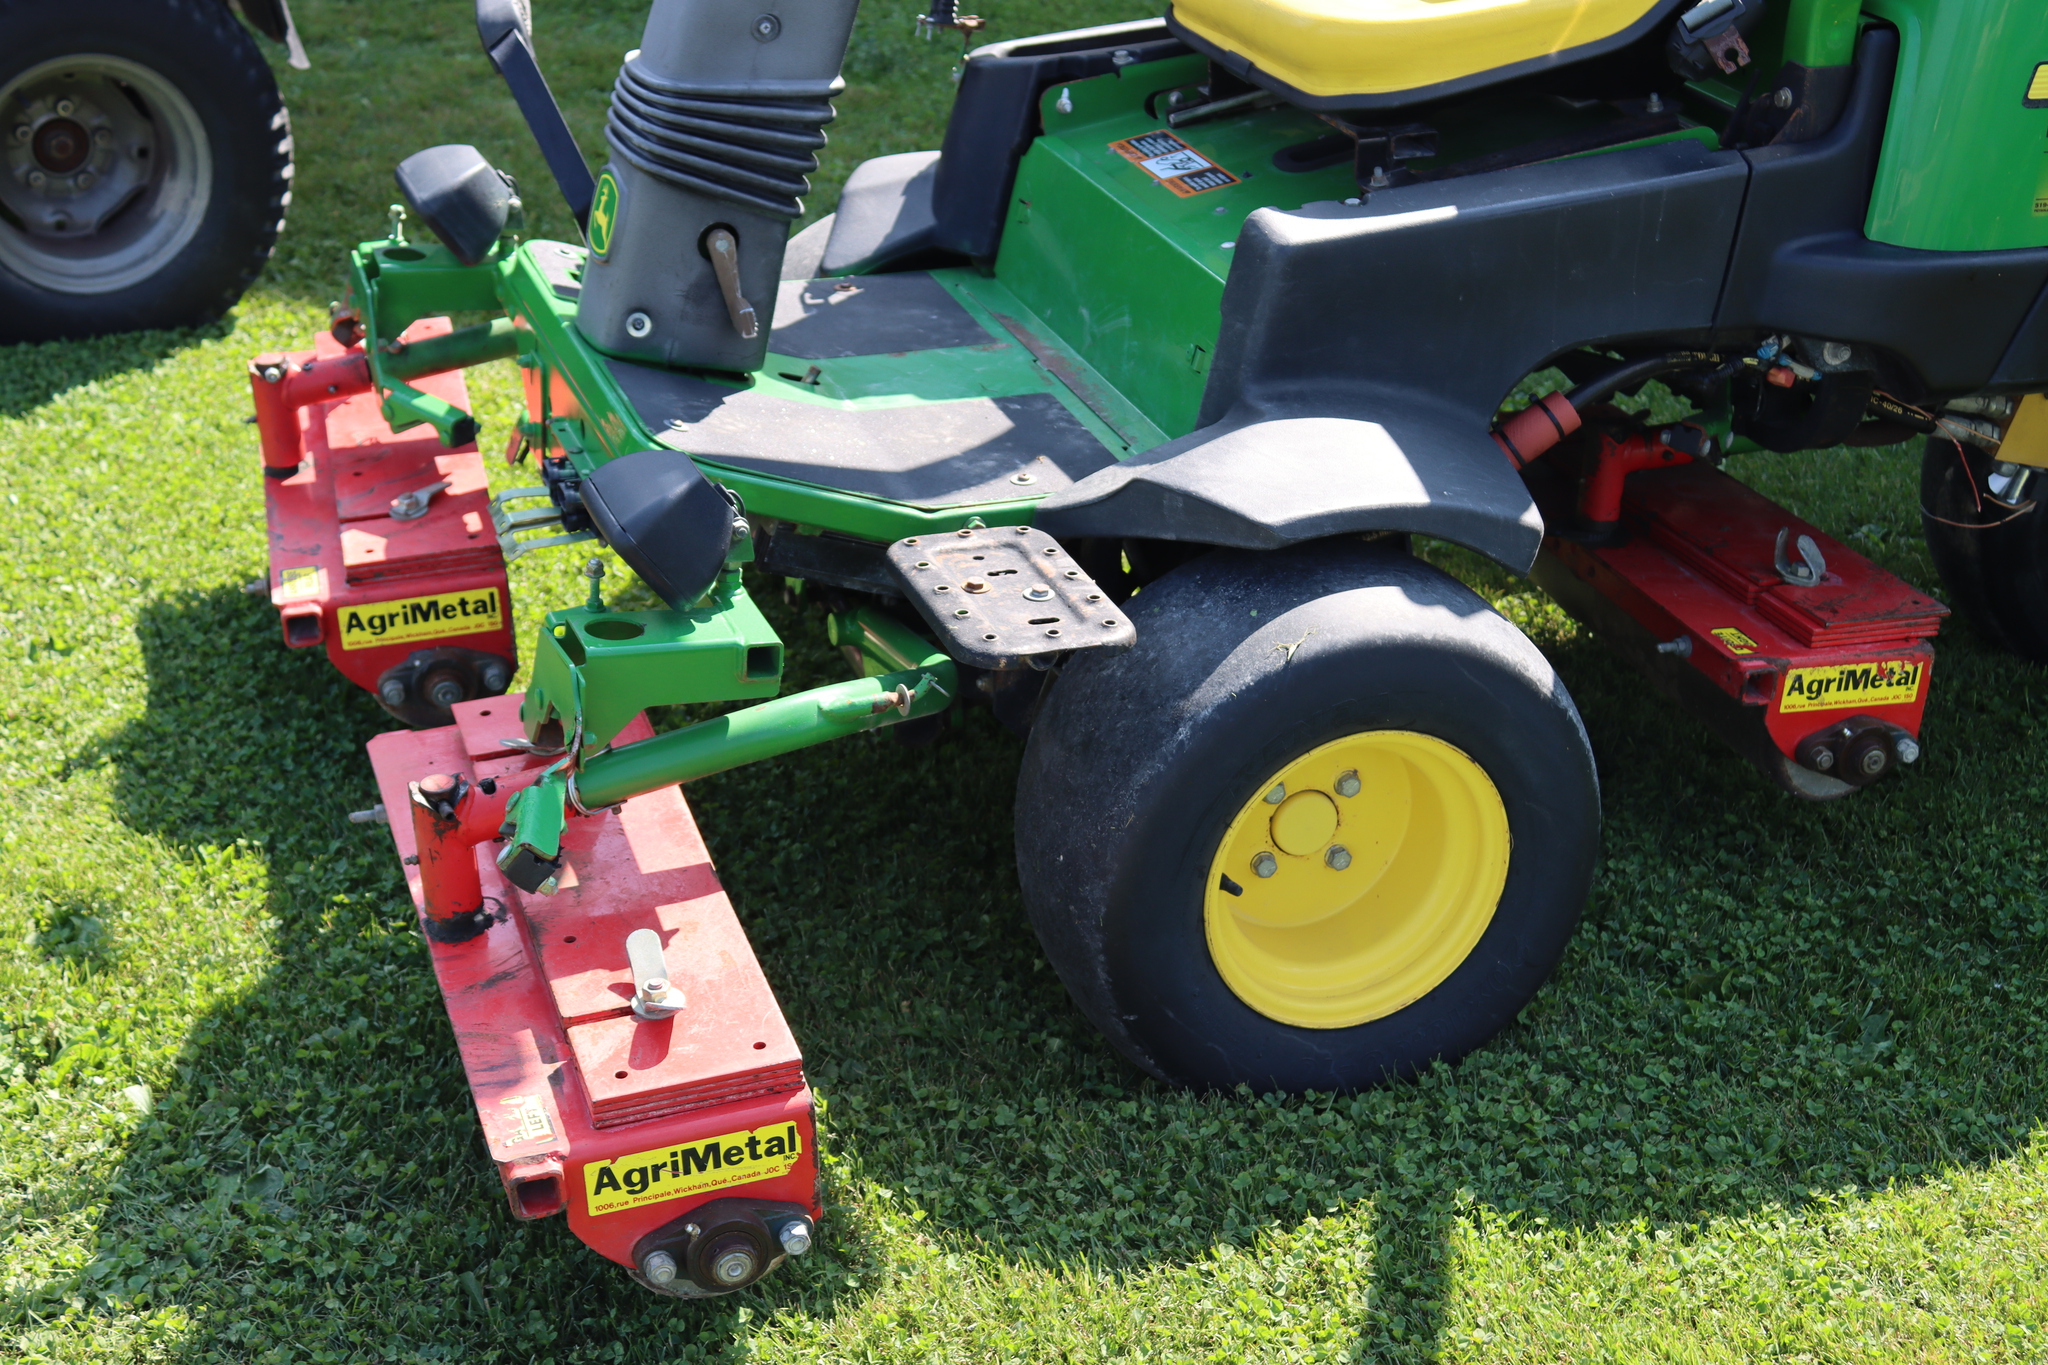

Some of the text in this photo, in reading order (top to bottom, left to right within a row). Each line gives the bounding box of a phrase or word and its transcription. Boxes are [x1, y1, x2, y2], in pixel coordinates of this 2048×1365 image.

[346, 592, 497, 635] AgriMetal
[1786, 666, 1919, 701] AgriMetal
[593, 1125, 798, 1196] AgriMetal
